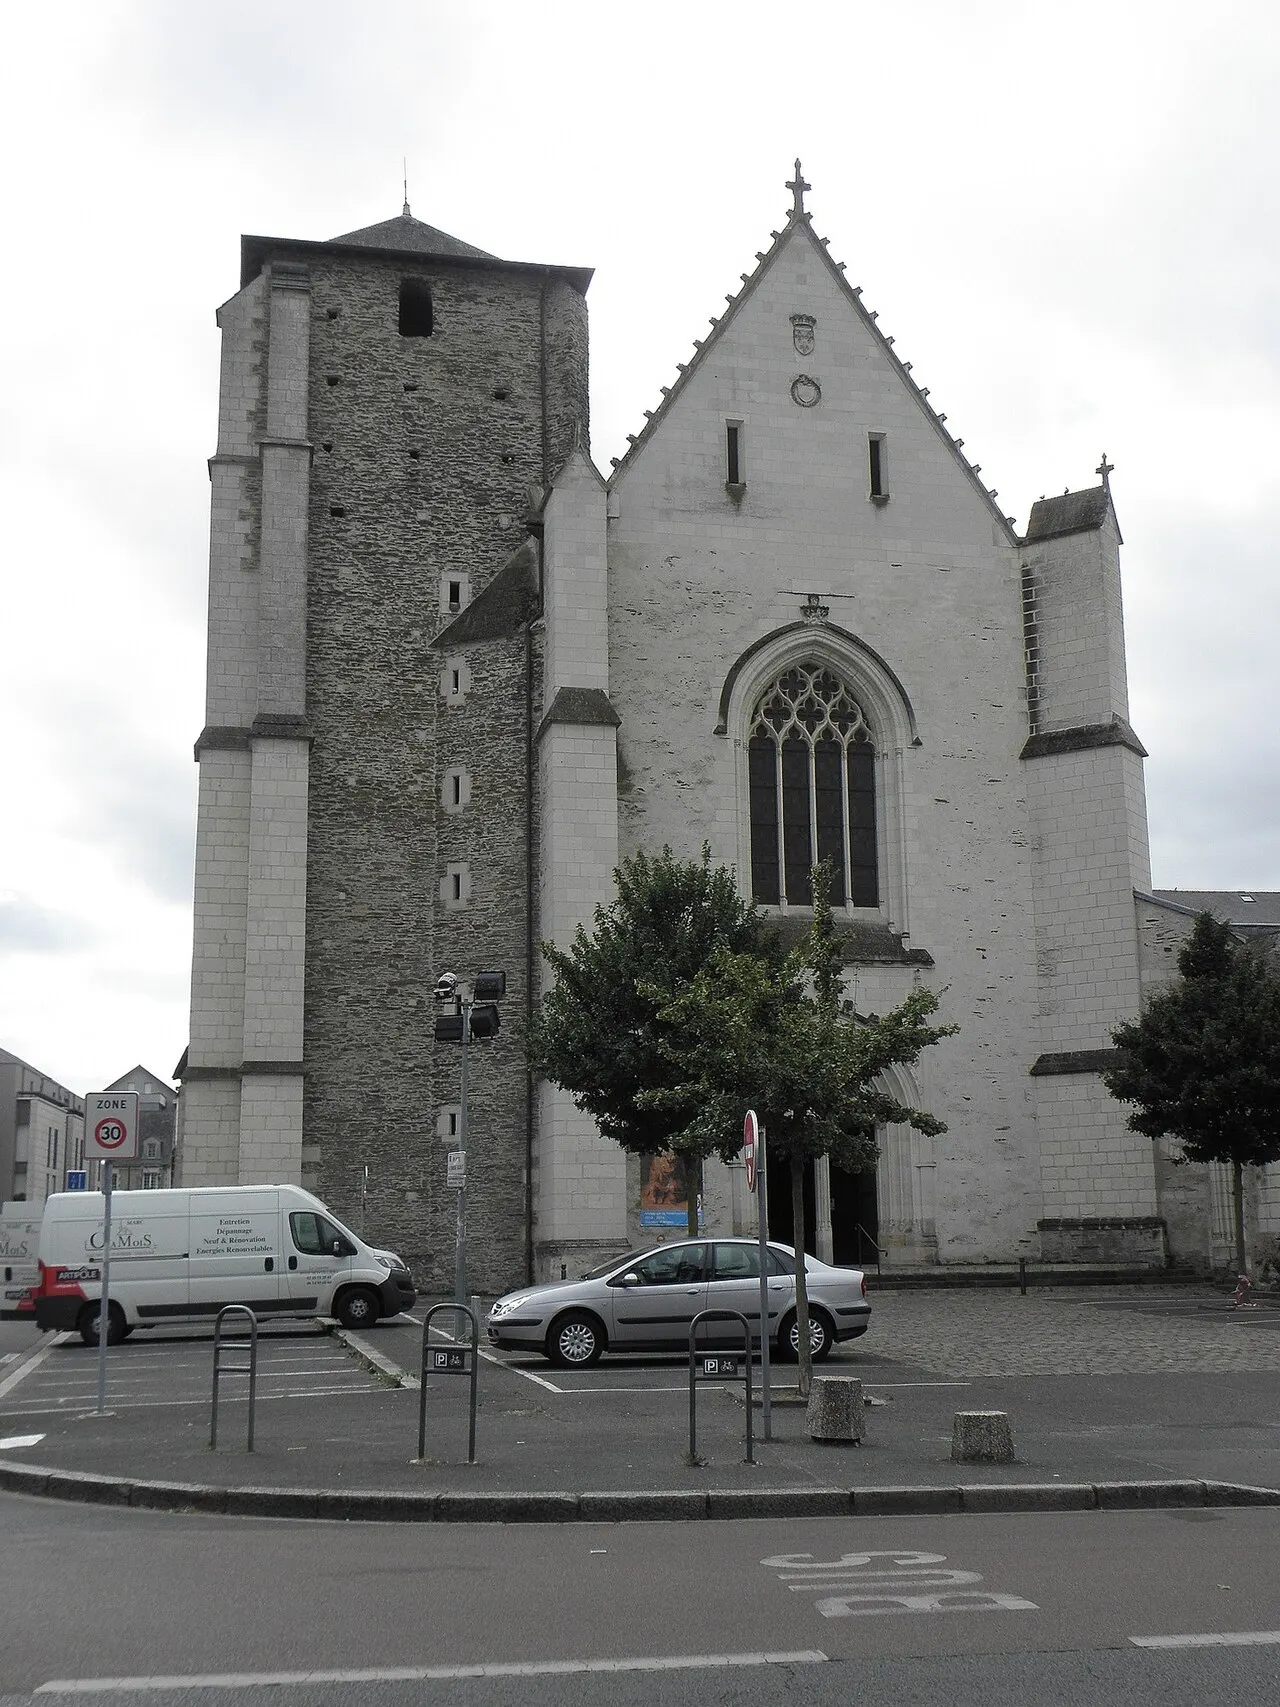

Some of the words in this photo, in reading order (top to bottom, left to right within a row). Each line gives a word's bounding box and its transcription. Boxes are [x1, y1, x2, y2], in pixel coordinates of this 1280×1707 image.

[96, 1100, 127, 1109] ZONE
[101, 1126, 121, 1140] 30
[216, 1228, 252, 1236] Dépannage
[229, 1236, 266, 1244] Rénovation
[226, 1245, 273, 1254] Renouvelables
[438, 1355, 445, 1365] P
[707, 1361, 716, 1371] P
[760, 1550, 1040, 1618] BUS
